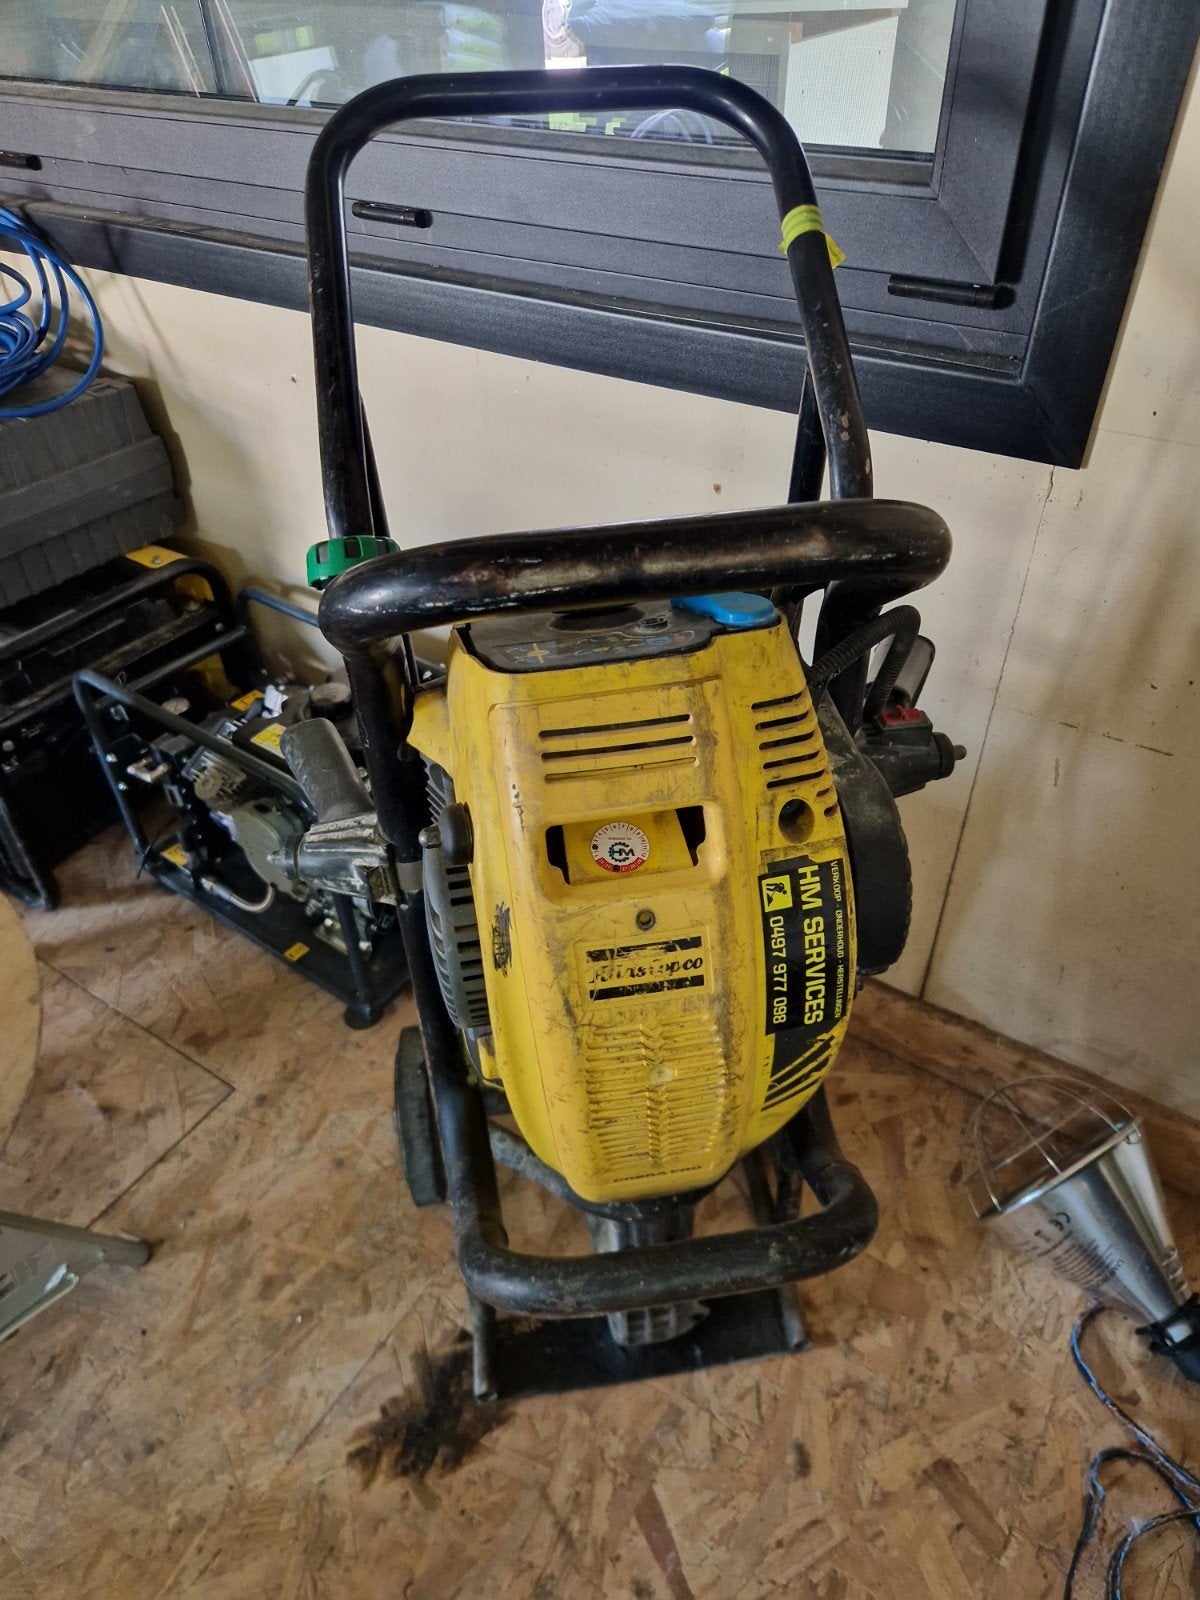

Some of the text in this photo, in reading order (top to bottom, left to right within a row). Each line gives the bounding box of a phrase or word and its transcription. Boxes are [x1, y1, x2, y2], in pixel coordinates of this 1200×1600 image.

[830, 861, 842, 902] VERKOOP
[798, 865, 826, 1025] HM SERVICES
[835, 910, 844, 958] ONDERHOUD
[769, 915, 788, 1024] 0497 977 098
[834, 965, 845, 1019] HERSTELLINGEN
